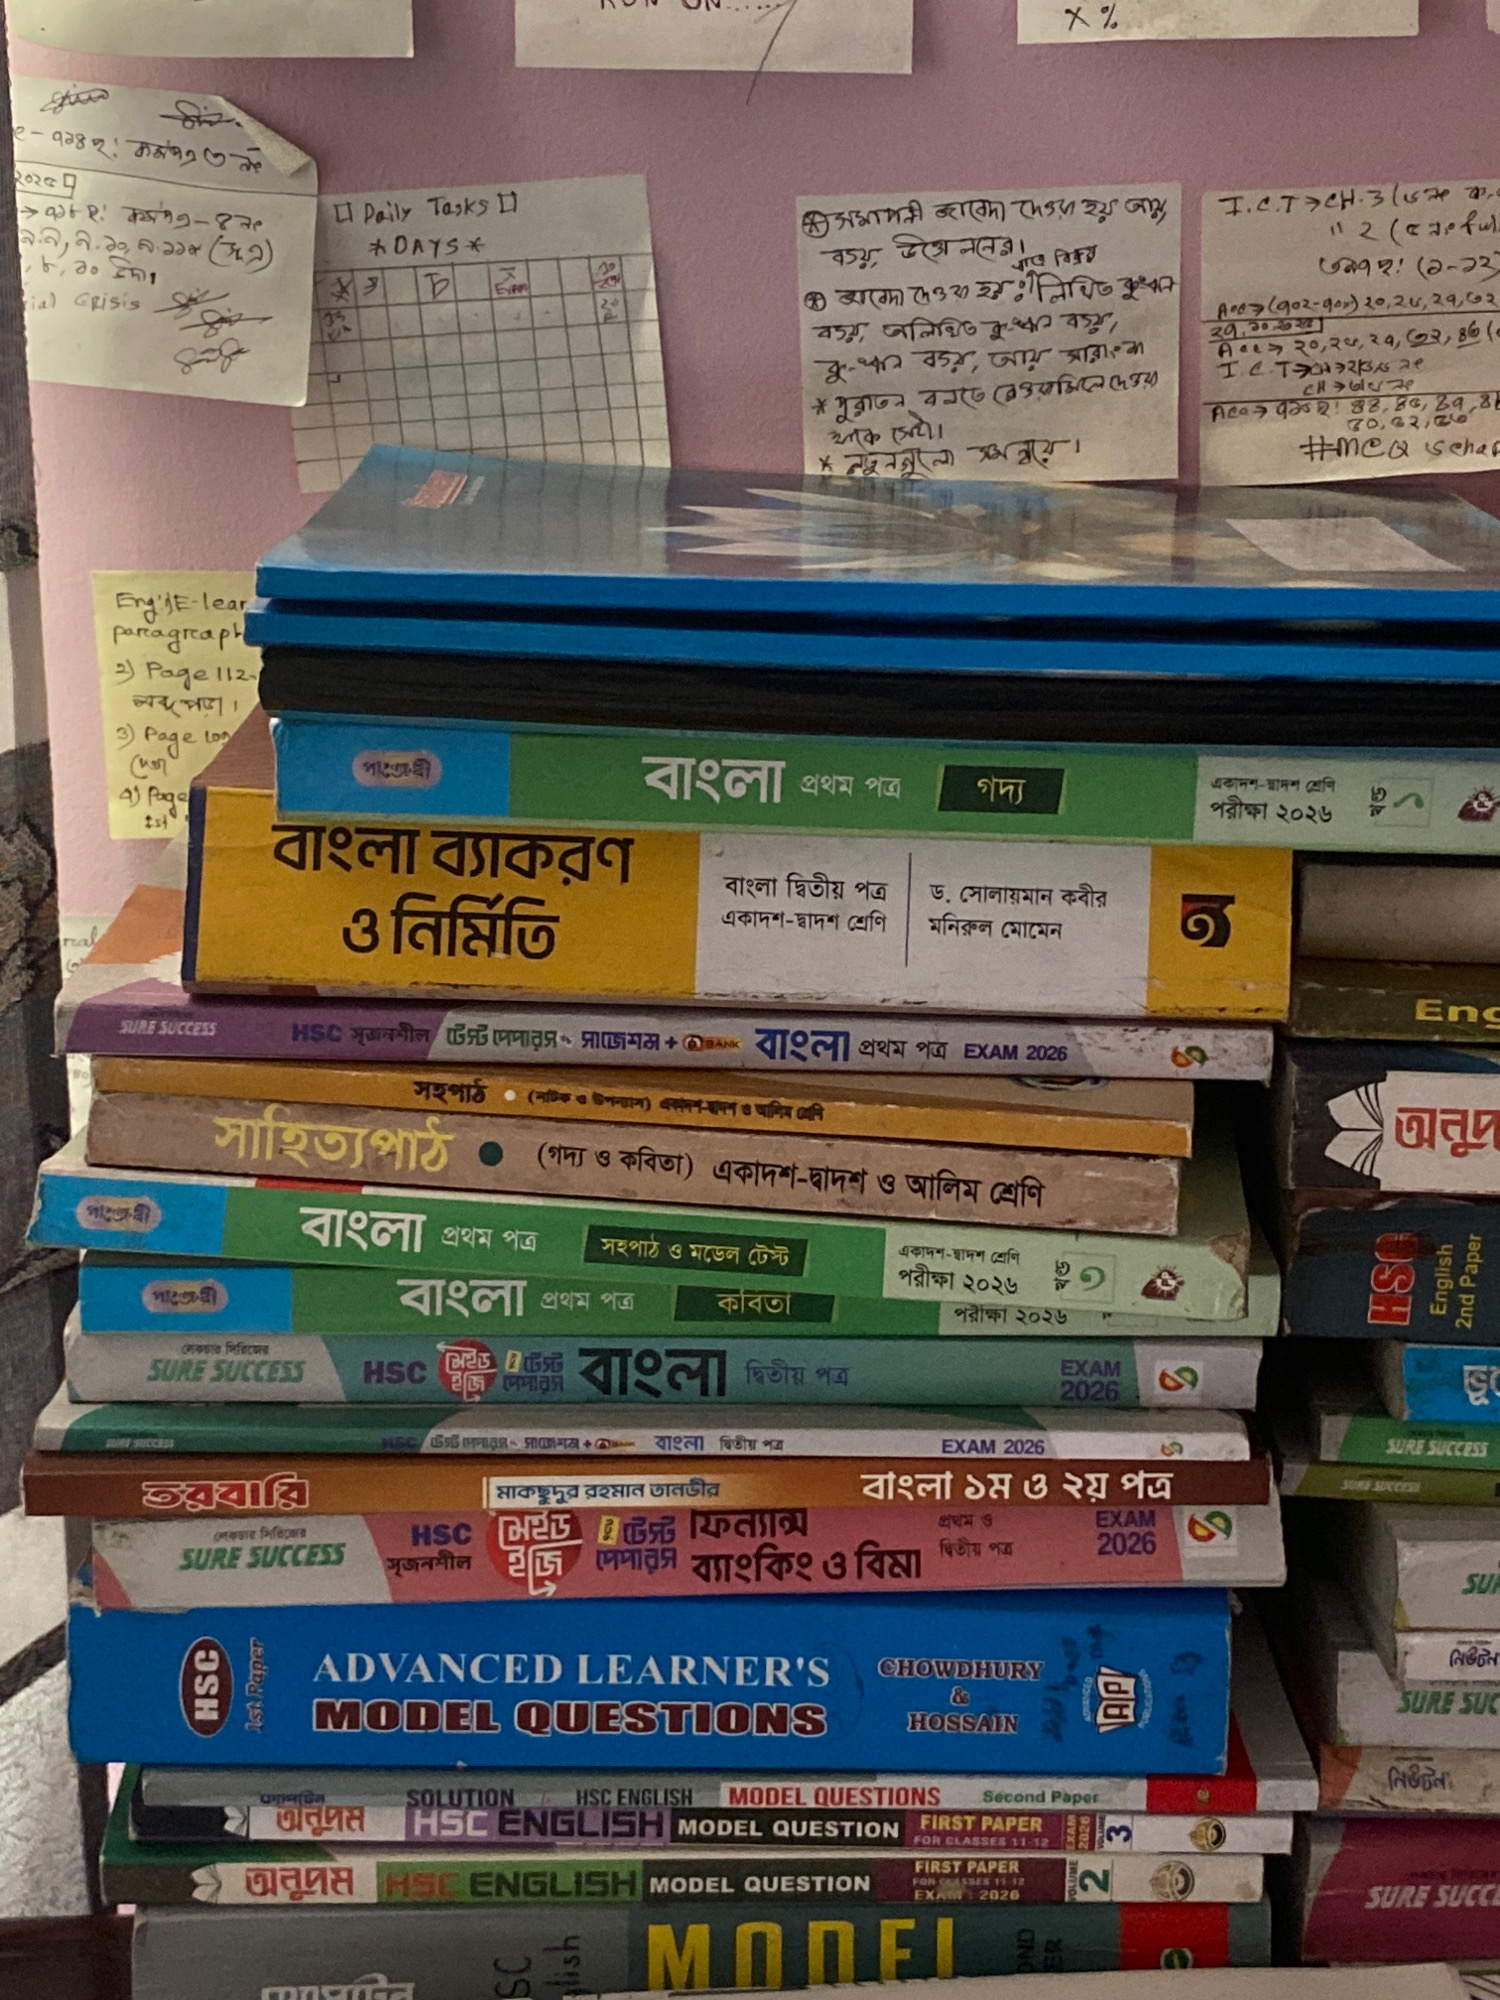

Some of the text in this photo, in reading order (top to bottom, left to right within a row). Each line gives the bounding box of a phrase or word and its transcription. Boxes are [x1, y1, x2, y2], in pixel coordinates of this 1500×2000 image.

[364, 195, 489, 225] Daily Tasks
[642, 756, 902, 805] বাংলা প্রথম পত্র
[976, 775, 1027, 805] গদ্য
[1210, 775, 1336, 794] একাদশ-দ্বাদশ শ্রেণি
[1210, 795, 1334, 824] পরীক্ষা ২০২৬
[271, 824, 636, 887] বাংলা ব্যাকরণ
[723, 871, 889, 902] বাংলা দ্বিতীয় পত্র
[929, 881, 1109, 909] ড. সোলায়মান কবীর
[341, 891, 561, 961] ও নির্মিতি
[721, 908, 887, 935] একাদশ-দ্বাদশ শ্রেণি
[928, 911, 1063, 941] মনিরুল মোমেন
[118, 1019, 218, 1038] SURE SUCCESS
[291, 1022, 489, 1051] HSC সৃজনশীল টেস্ট
[754, 1027, 1069, 1064] বাংলা প্রথম পত্র EXAM 2026
[413, 1077, 489, 1106] সহপাঠ
[211, 1102, 1047, 1210] সাহিত্যপাঠ (গদ্য ও কবিতা) একাদশ-দ্বাদশ ও আলিম শ্রেণি
[299, 1206, 540, 1254] বাংলা প্রথম পত্র
[600, 1232, 792, 1268] সহপাঠ ও মডেল টেস্ট
[898, 1244, 1021, 1267] একাদশ-দ্বাদশ শ্রেণি
[898, 1262, 1019, 1296] পরীক্ষা ২০২৬
[1367, 1231, 1420, 1326] HSC
[1429, 1242, 1455, 1317] English
[1454, 1232, 1485, 1331] 2nd Paper
[397, 1278, 636, 1319] বাংলা প্রথম পত্র
[1015, 1306, 1069, 1327] ২০২৬
[147, 1358, 307, 1384] SURE SUCCESS
[363, 1360, 428, 1386] HSC
[578, 1347, 851, 1399] বাংলা দ্বিতীয় পত্র
[1060, 1359, 1122, 1379] EXAM
[1060, 1379, 1121, 1402] 2026
[654, 1434, 1046, 1456] বাংলা EXAM 2026
[1385, 1437, 1490, 1459] SURE SUCCESS
[141, 1471, 310, 1513] তরবারি
[584, 1483, 646, 1501] রহমান
[860, 1470, 1175, 1503] বাংলা ১ম ও ২য় পত্র
[623, 1515, 677, 1545] টেস্ট
[939, 1511, 994, 1530] প্রথম ও
[1096, 1510, 1156, 1529] EXAM
[411, 1522, 473, 1547] HSC
[988, 1540, 1014, 1558] পত্র
[1097, 1531, 1157, 1557] 2026
[179, 1542, 347, 1571] SURE SUCCESS
[387, 1550, 472, 1577] সৃজনশীল
[596, 1549, 678, 1575] পেপারস
[692, 1539, 923, 1584] ব্যাংকিং ও বিমা
[313, 1652, 831, 1688] ADVANCED LEARNER'S
[878, 1656, 1045, 1681] CHOWDHURY
[193, 1648, 220, 1722] HSC
[951, 1685, 971, 1706] &
[1397, 1689, 1456, 1715] SURE
[312, 1697, 828, 1738] MODEL QUESTIONS
[907, 1711, 1020, 1735] HOSSAIN
[406, 1786, 1100, 1808] SOLUTION HSC ENGLISH MODEL QUESTIONS Second Paper
[276, 1804, 1043, 1840] অনুপম HSC ENGLISH MODEL QUESTION FIRST PAPER
[1078, 1814, 1091, 1851] 2026
[1105, 1824, 1133, 1843] 3
[913, 1836, 1007, 1848] FOR CLASSES
[245, 1859, 1021, 1901] অনুপম HSC ENGLISH MODEL QUESTION FIRST PAPER
[1078, 1868, 1111, 1895] 2
[1364, 1884, 1432, 1910] SURE
